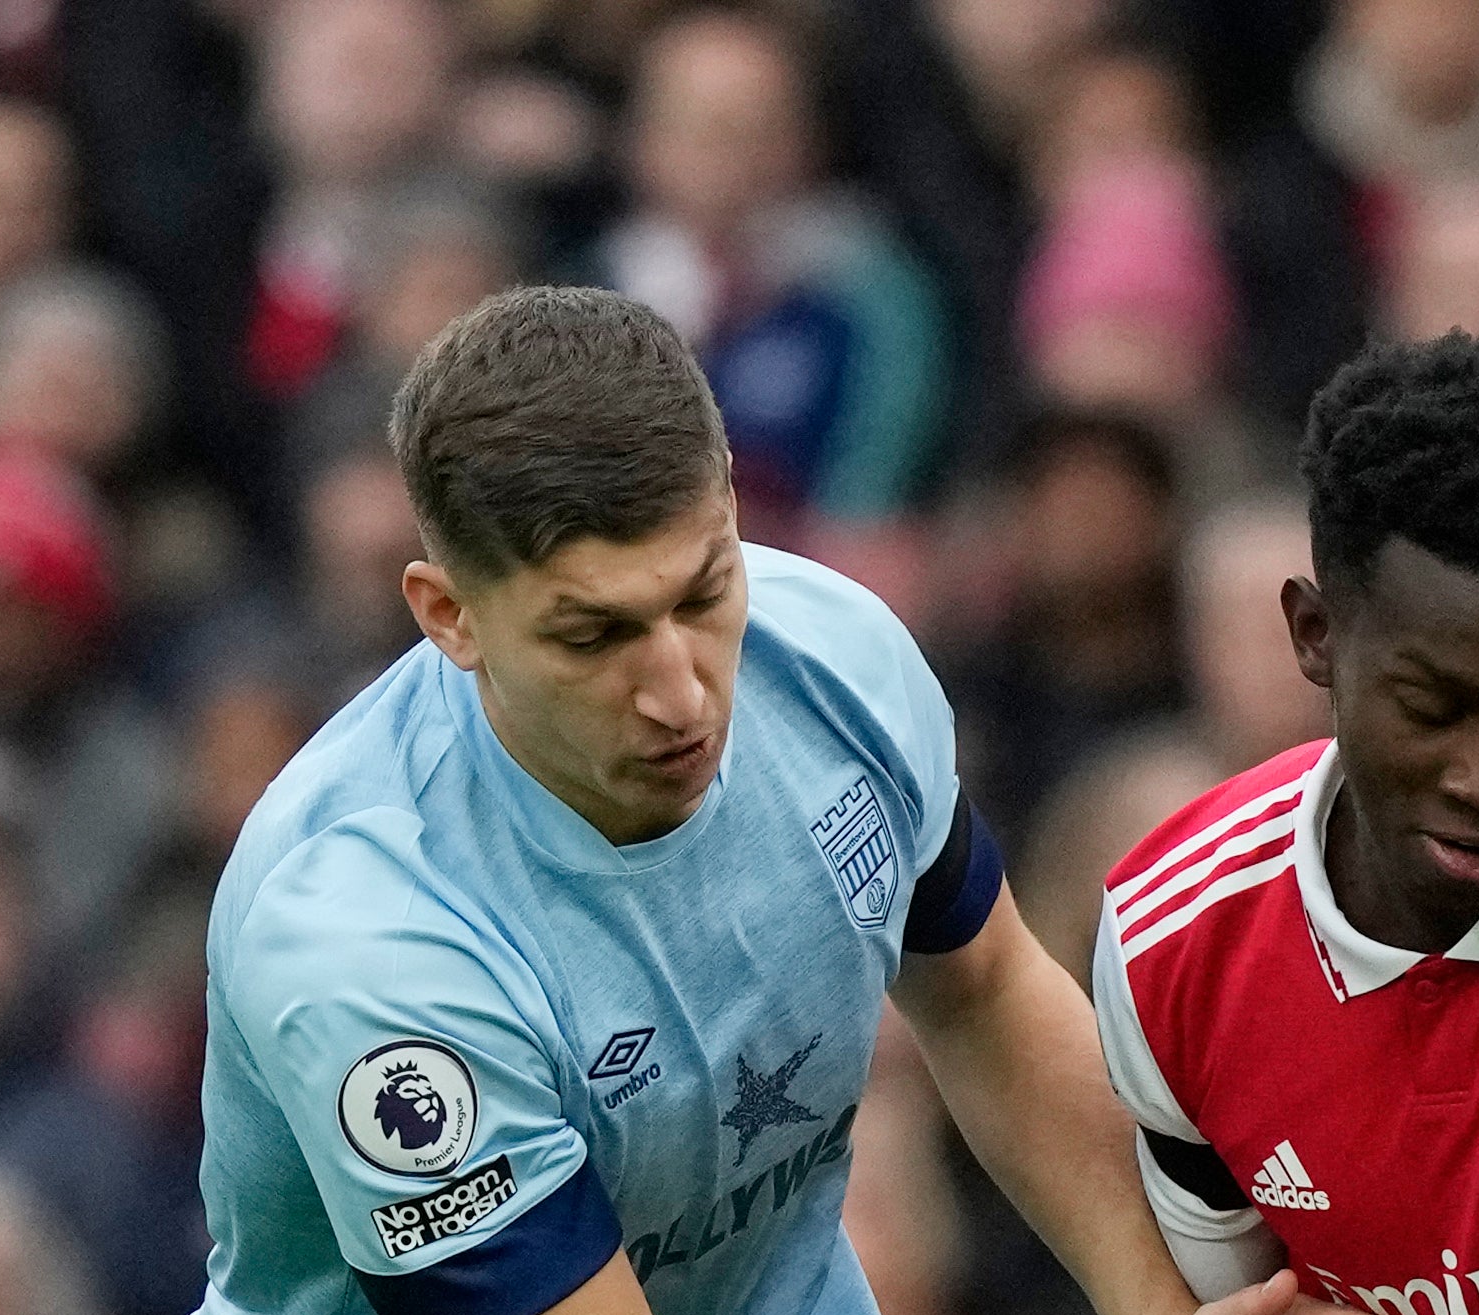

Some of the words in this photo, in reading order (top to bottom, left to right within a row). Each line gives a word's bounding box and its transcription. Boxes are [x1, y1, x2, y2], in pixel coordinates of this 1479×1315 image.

[866, 813, 879, 831] FC
[604, 1062, 661, 1110] umbro
[414, 1143, 455, 1167] Premier
[451, 1097, 467, 1143] League
[372, 1205, 421, 1235] No
[422, 1169, 500, 1219] room
[382, 1223, 426, 1258] for
[429, 1178, 516, 1239] racism
[1251, 1181, 1330, 1210] adidas
